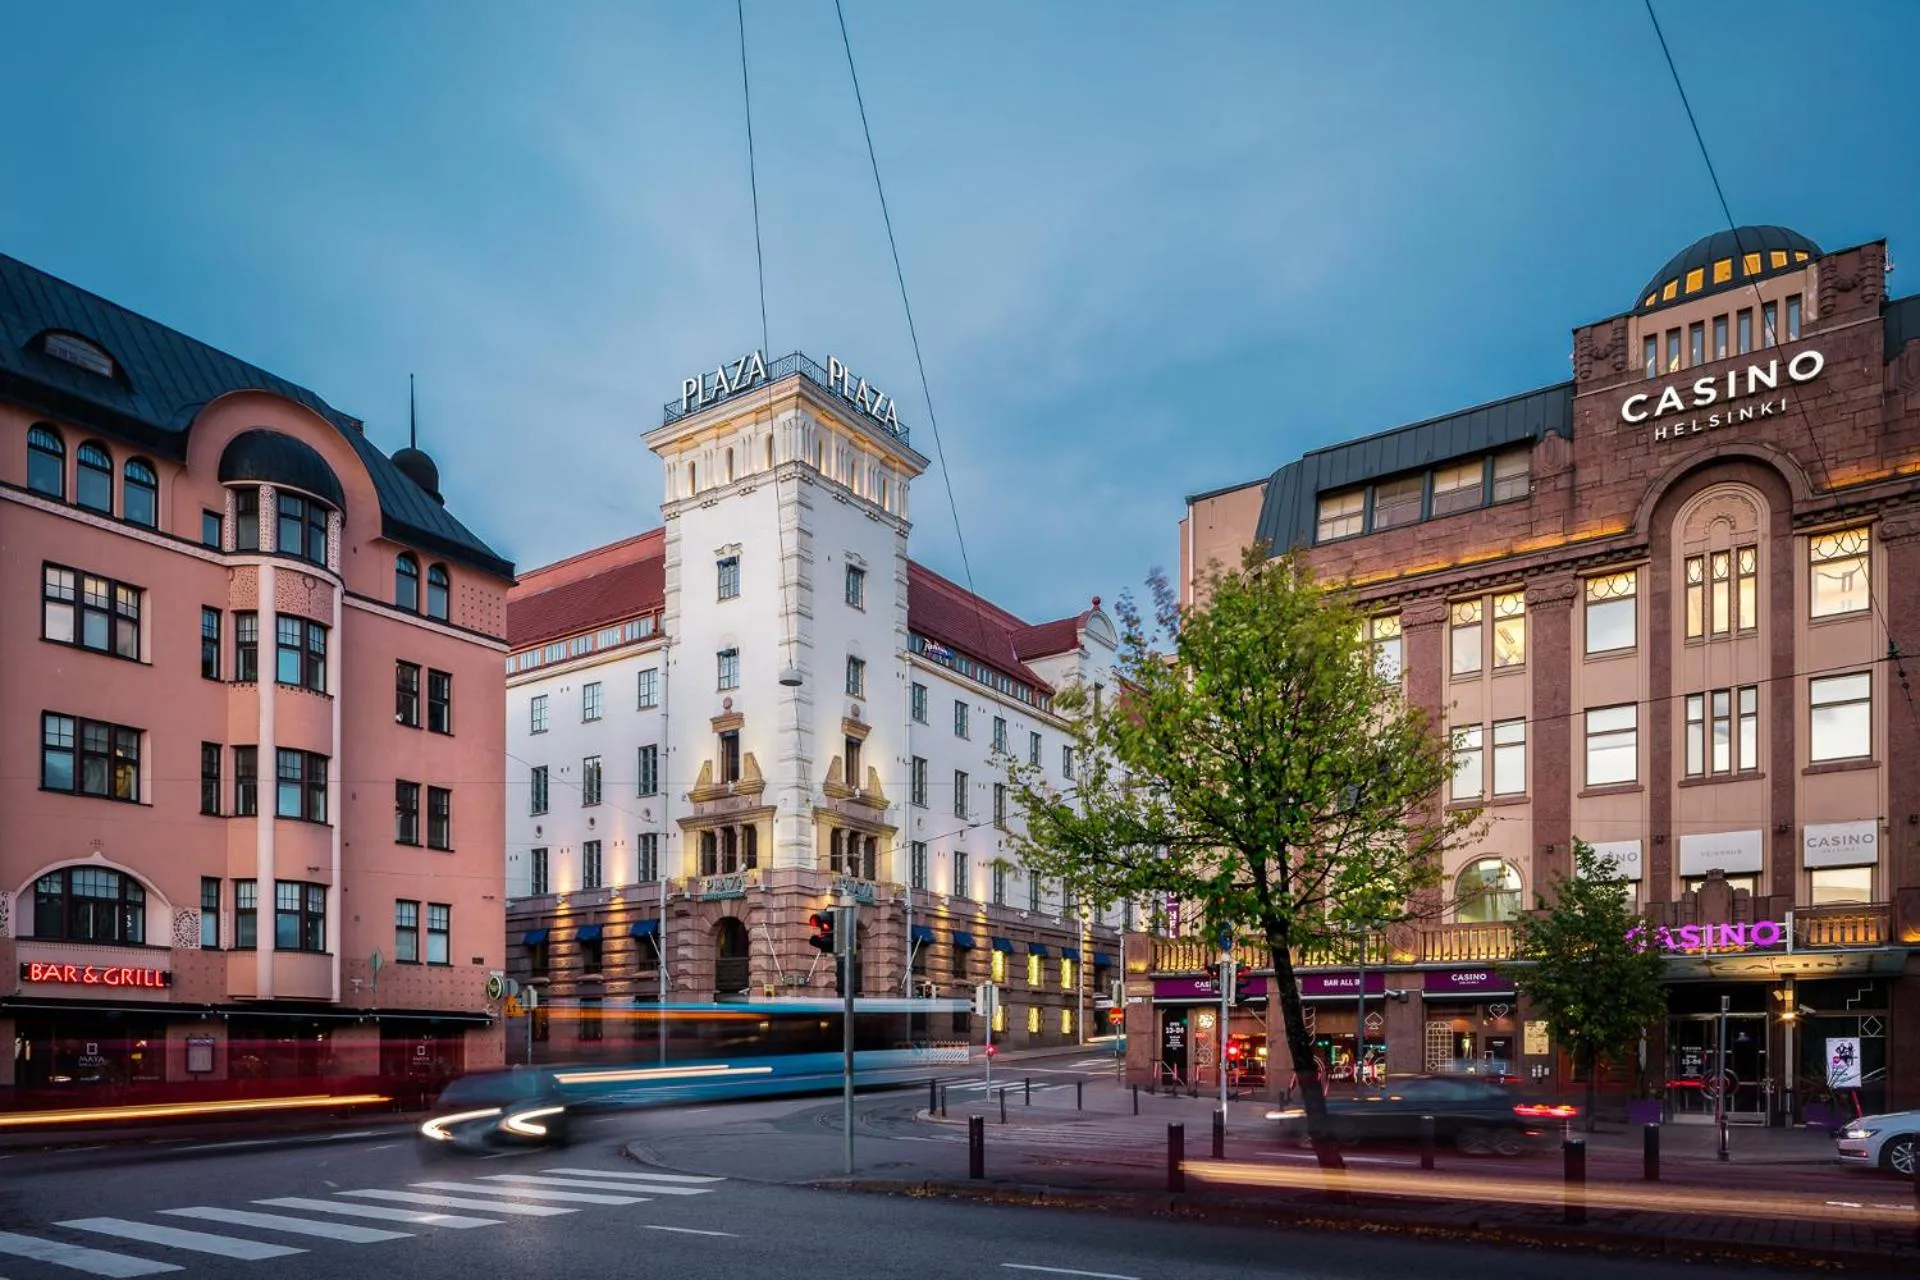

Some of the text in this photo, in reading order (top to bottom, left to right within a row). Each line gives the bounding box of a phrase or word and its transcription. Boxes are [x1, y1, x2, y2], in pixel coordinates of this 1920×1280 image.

[682, 350, 768, 412] PLAZA
[827, 355, 901, 433] PLAZA
[1621, 350, 1825, 423] CASINO
[1655, 398, 1787, 441] HELSINKI
[1807, 833, 1874, 848] CASINO
[30, 963, 164, 987] BAR & GRILL
[1451, 973, 1487, 981] CASINO
